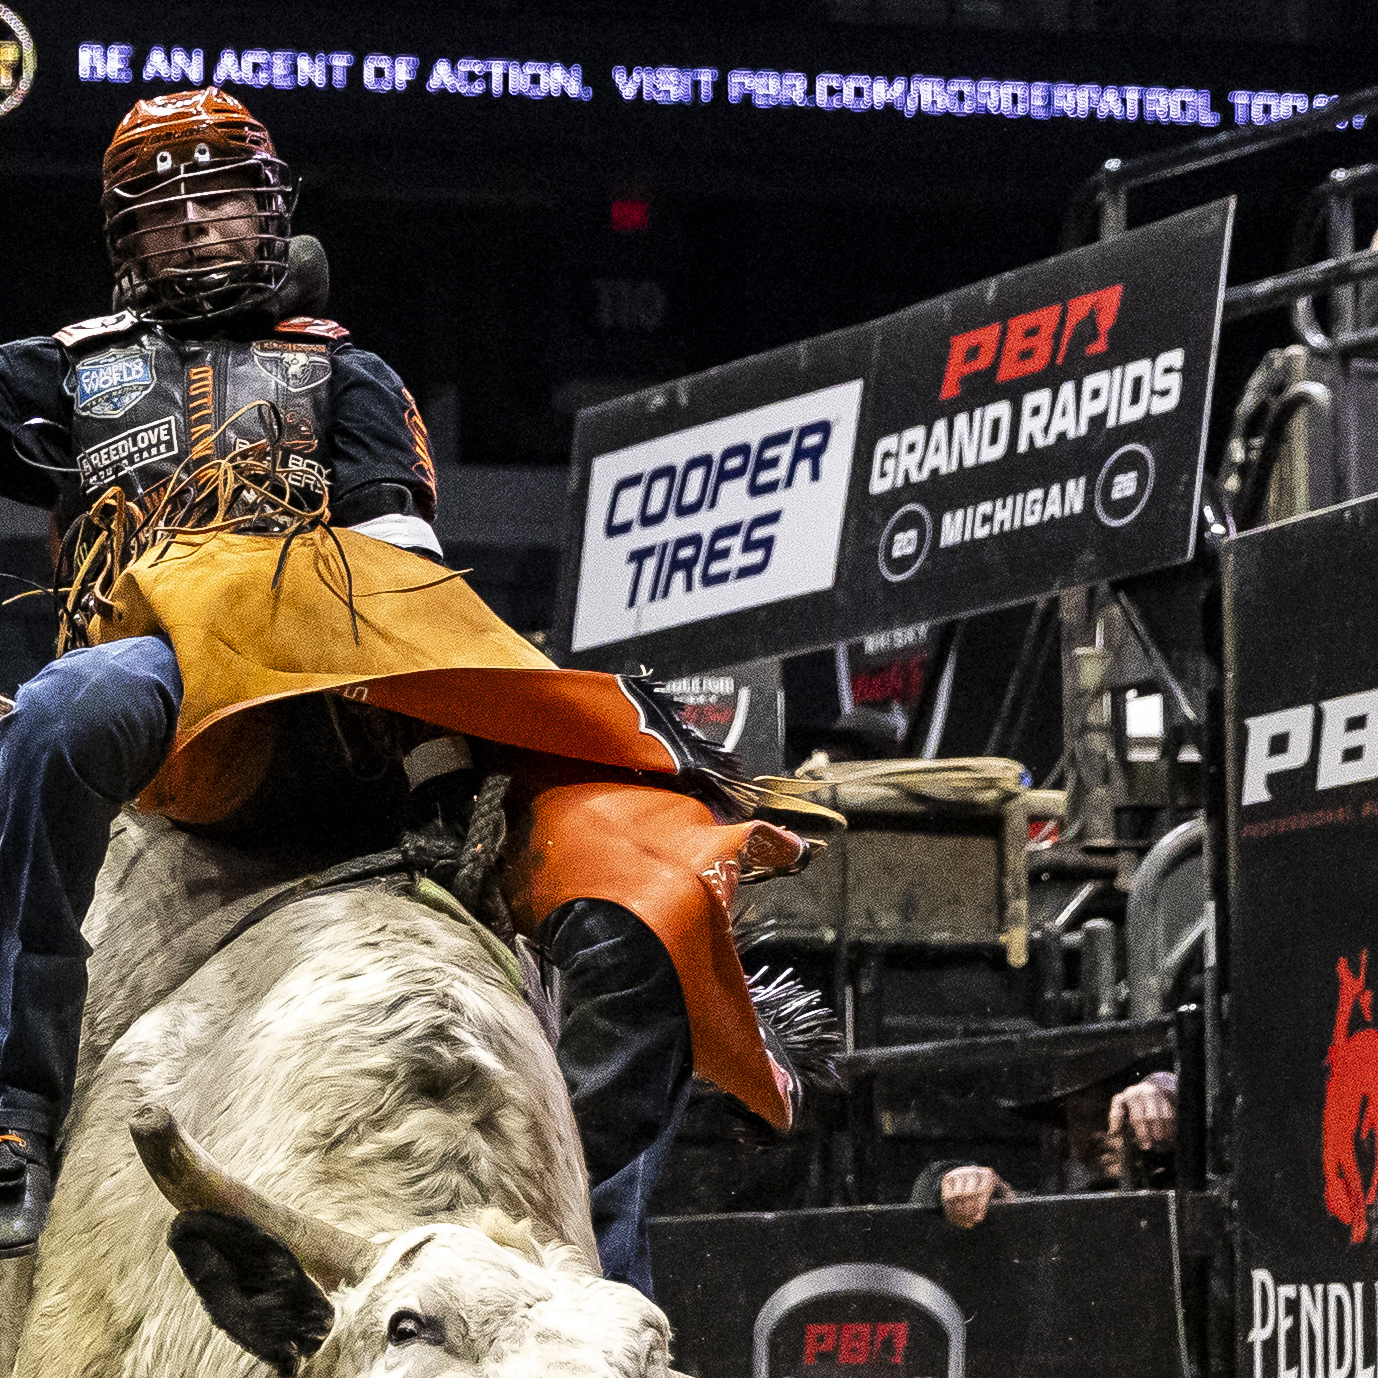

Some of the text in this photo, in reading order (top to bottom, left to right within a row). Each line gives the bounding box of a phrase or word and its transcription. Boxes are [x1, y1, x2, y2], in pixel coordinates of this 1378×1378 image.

[78, 40, 133, 84] BE
[142, 45, 204, 86] AN
[216, 48, 354, 89] AGENT
[363, 51, 420, 93] OF
[612, 65, 718, 105] VISIT
[938, 284, 1124, 400] PBR
[83, 367, 144, 394] WORLD
[81, 424, 171, 476] BREEDLOVE
[134, 443, 168, 463] CARE
[869, 348, 1185, 495] GRAND RAPIDS
[603, 418, 833, 539] COOPER
[938, 476, 1087, 549] MICHIGAN
[624, 509, 783, 609] TIRES
[803, 1322, 909, 1366] PBR
